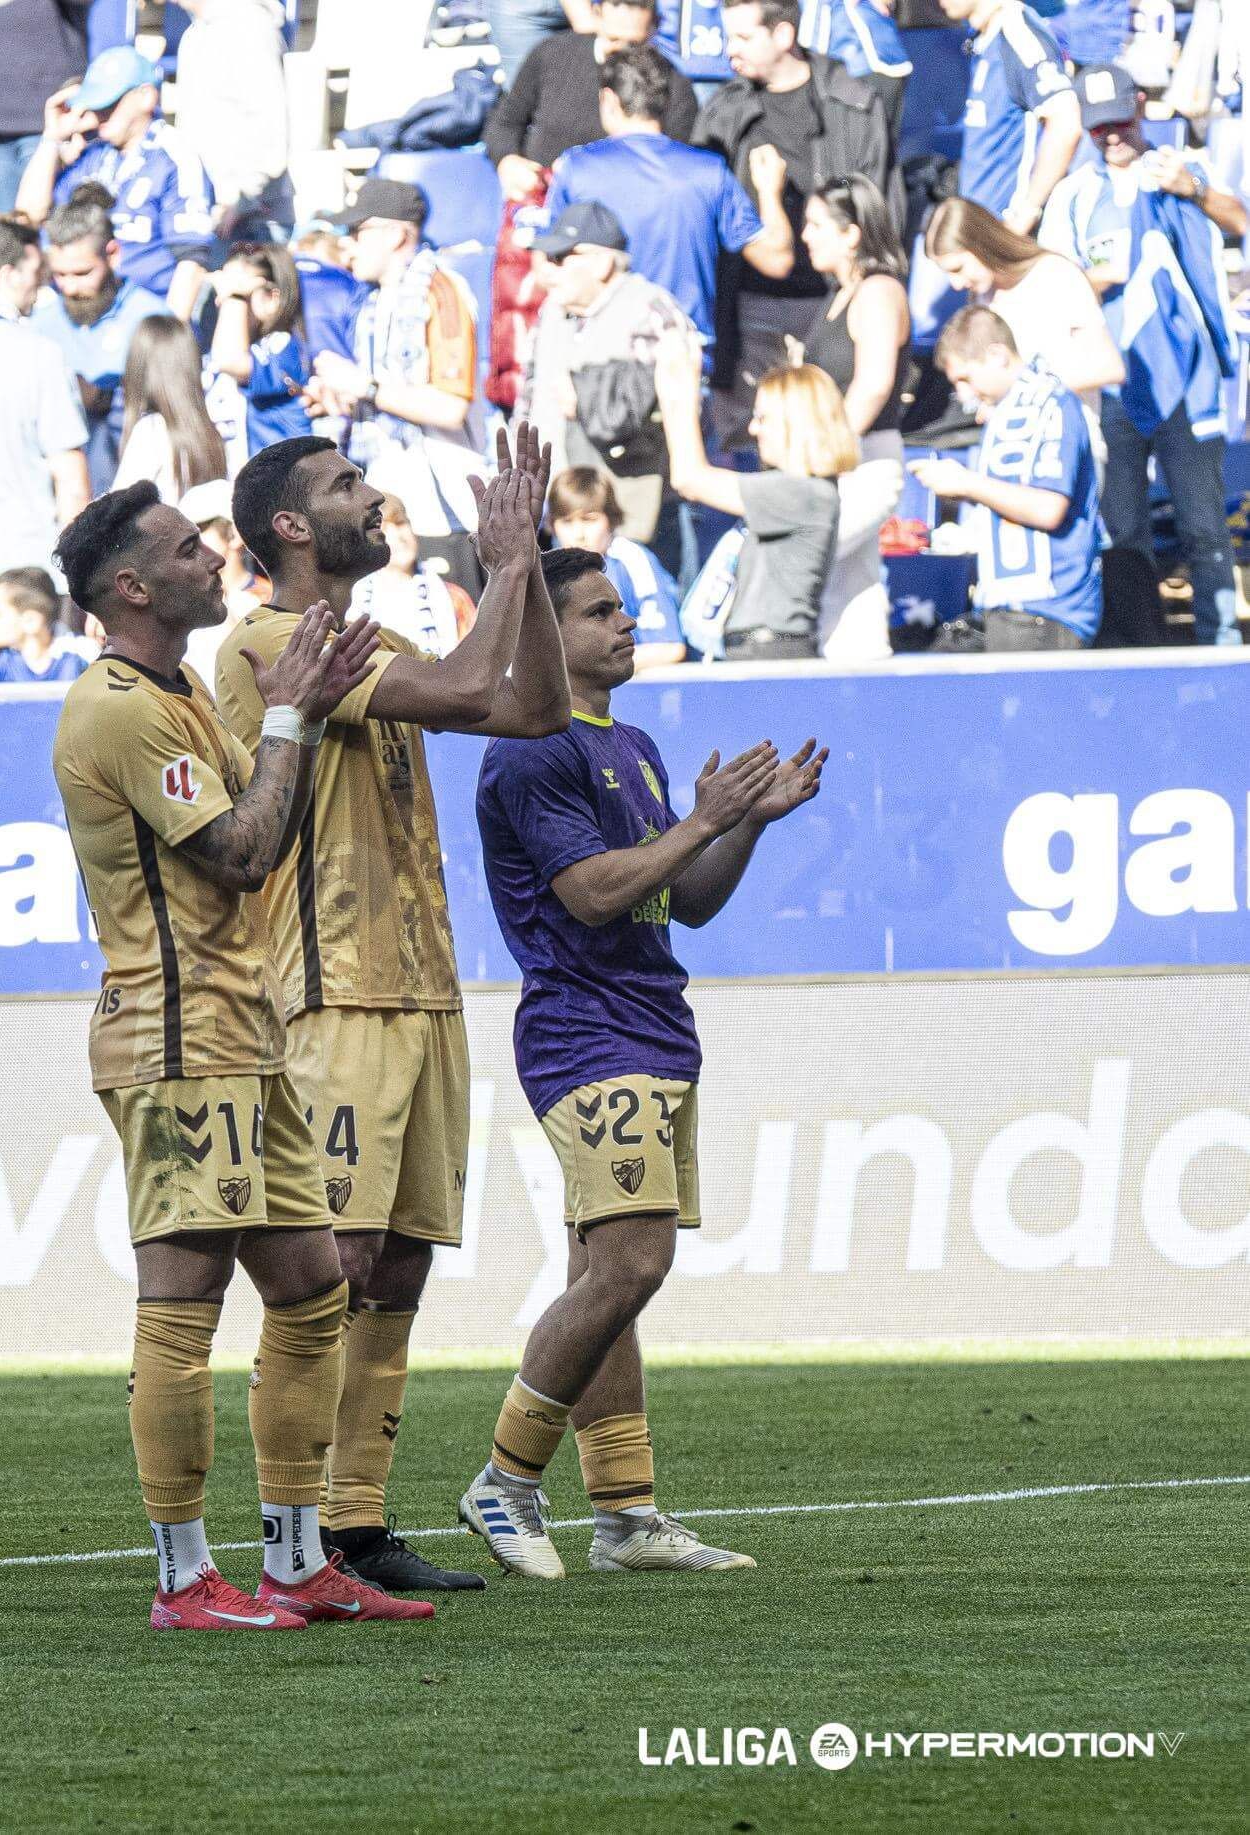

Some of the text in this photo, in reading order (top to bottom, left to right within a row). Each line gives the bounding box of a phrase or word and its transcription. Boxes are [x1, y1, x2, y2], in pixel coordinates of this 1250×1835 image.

[1003, 788, 1250, 955] ga
[325, 1105, 360, 1166] 4
[608, 1088, 672, 1148] 23
